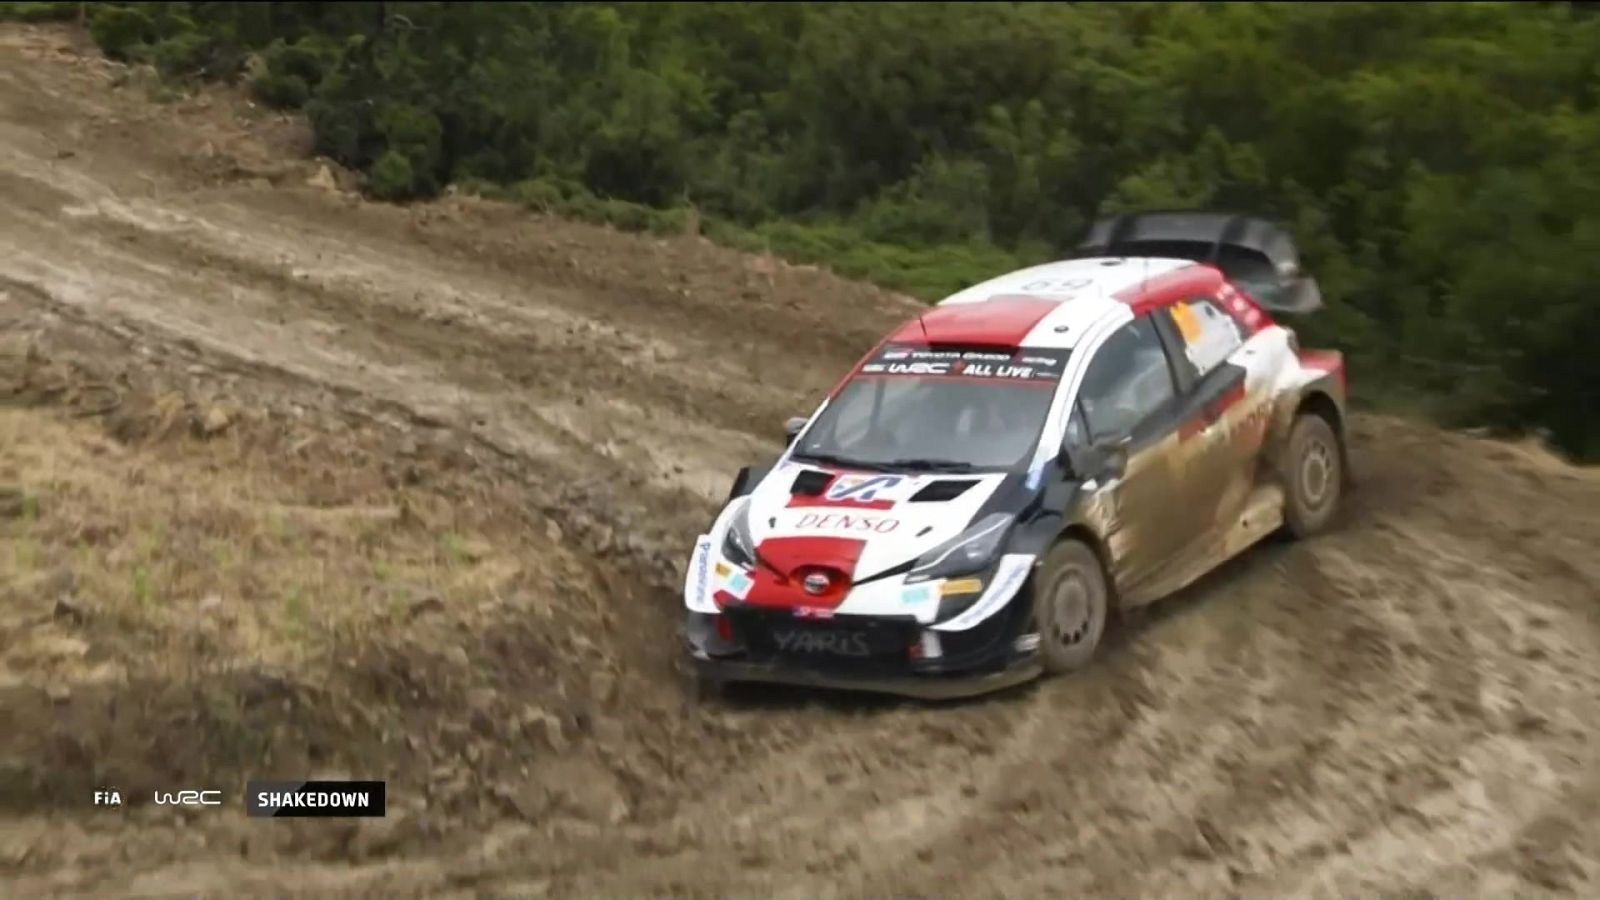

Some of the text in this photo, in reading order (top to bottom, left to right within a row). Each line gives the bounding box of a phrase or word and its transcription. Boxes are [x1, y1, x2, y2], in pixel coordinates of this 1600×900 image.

[888, 362, 950, 374] WRC
[962, 364, 992, 376] ALL
[996, 365, 1034, 378] LIVE
[795, 512, 900, 534] DENSO
